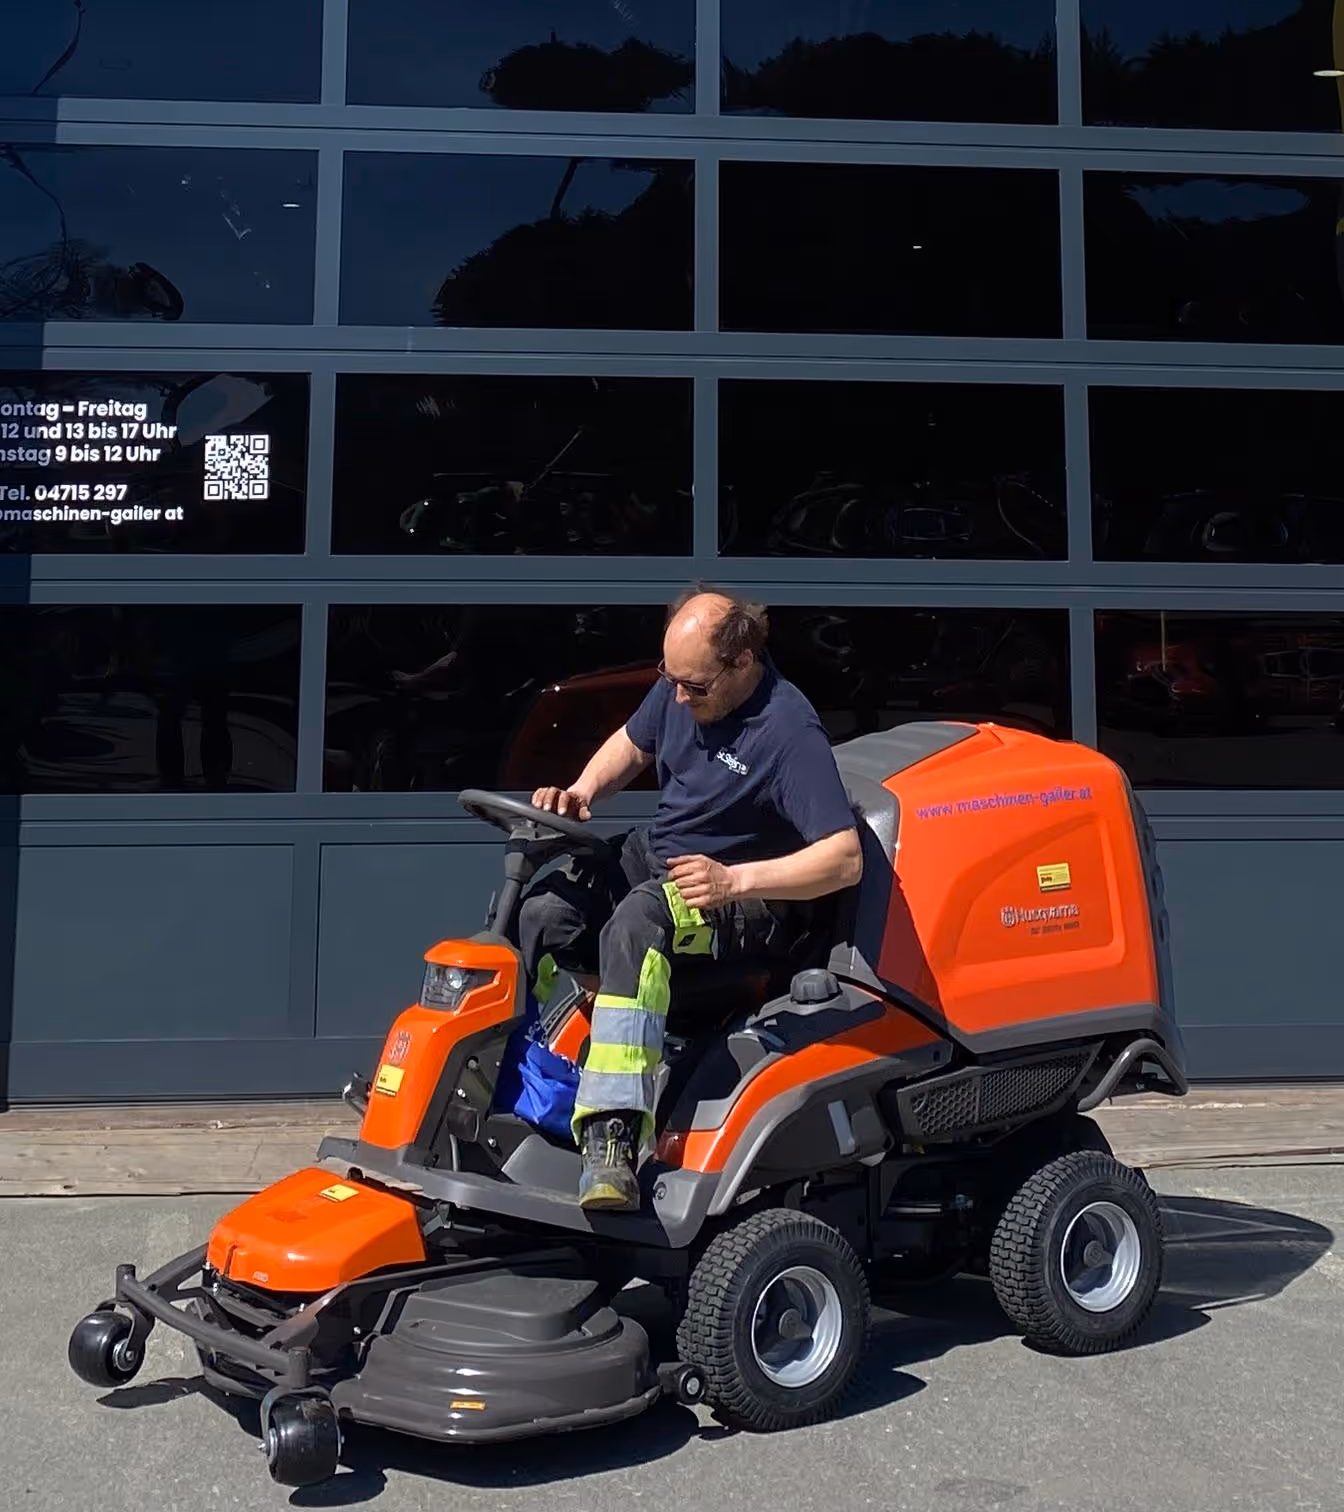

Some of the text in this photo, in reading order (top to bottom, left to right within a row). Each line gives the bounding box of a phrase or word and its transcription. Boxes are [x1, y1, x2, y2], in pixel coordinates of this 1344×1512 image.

[78, 399, 148, 422] Freitag
[1, 422, 19, 440] 12
[24, 422, 62, 440] und
[65, 422, 84, 440] 13
[88, 422, 117, 440] bis
[121, 422, 140, 440] 17
[142, 422, 177, 440] Uhr
[55, 445, 68, 462] 9
[70, 444, 101, 462] bis
[104, 445, 123, 462] 12
[126, 445, 161, 462] Uhr
[35, 484, 90, 501] 04715
[93, 484, 128, 501] 297
